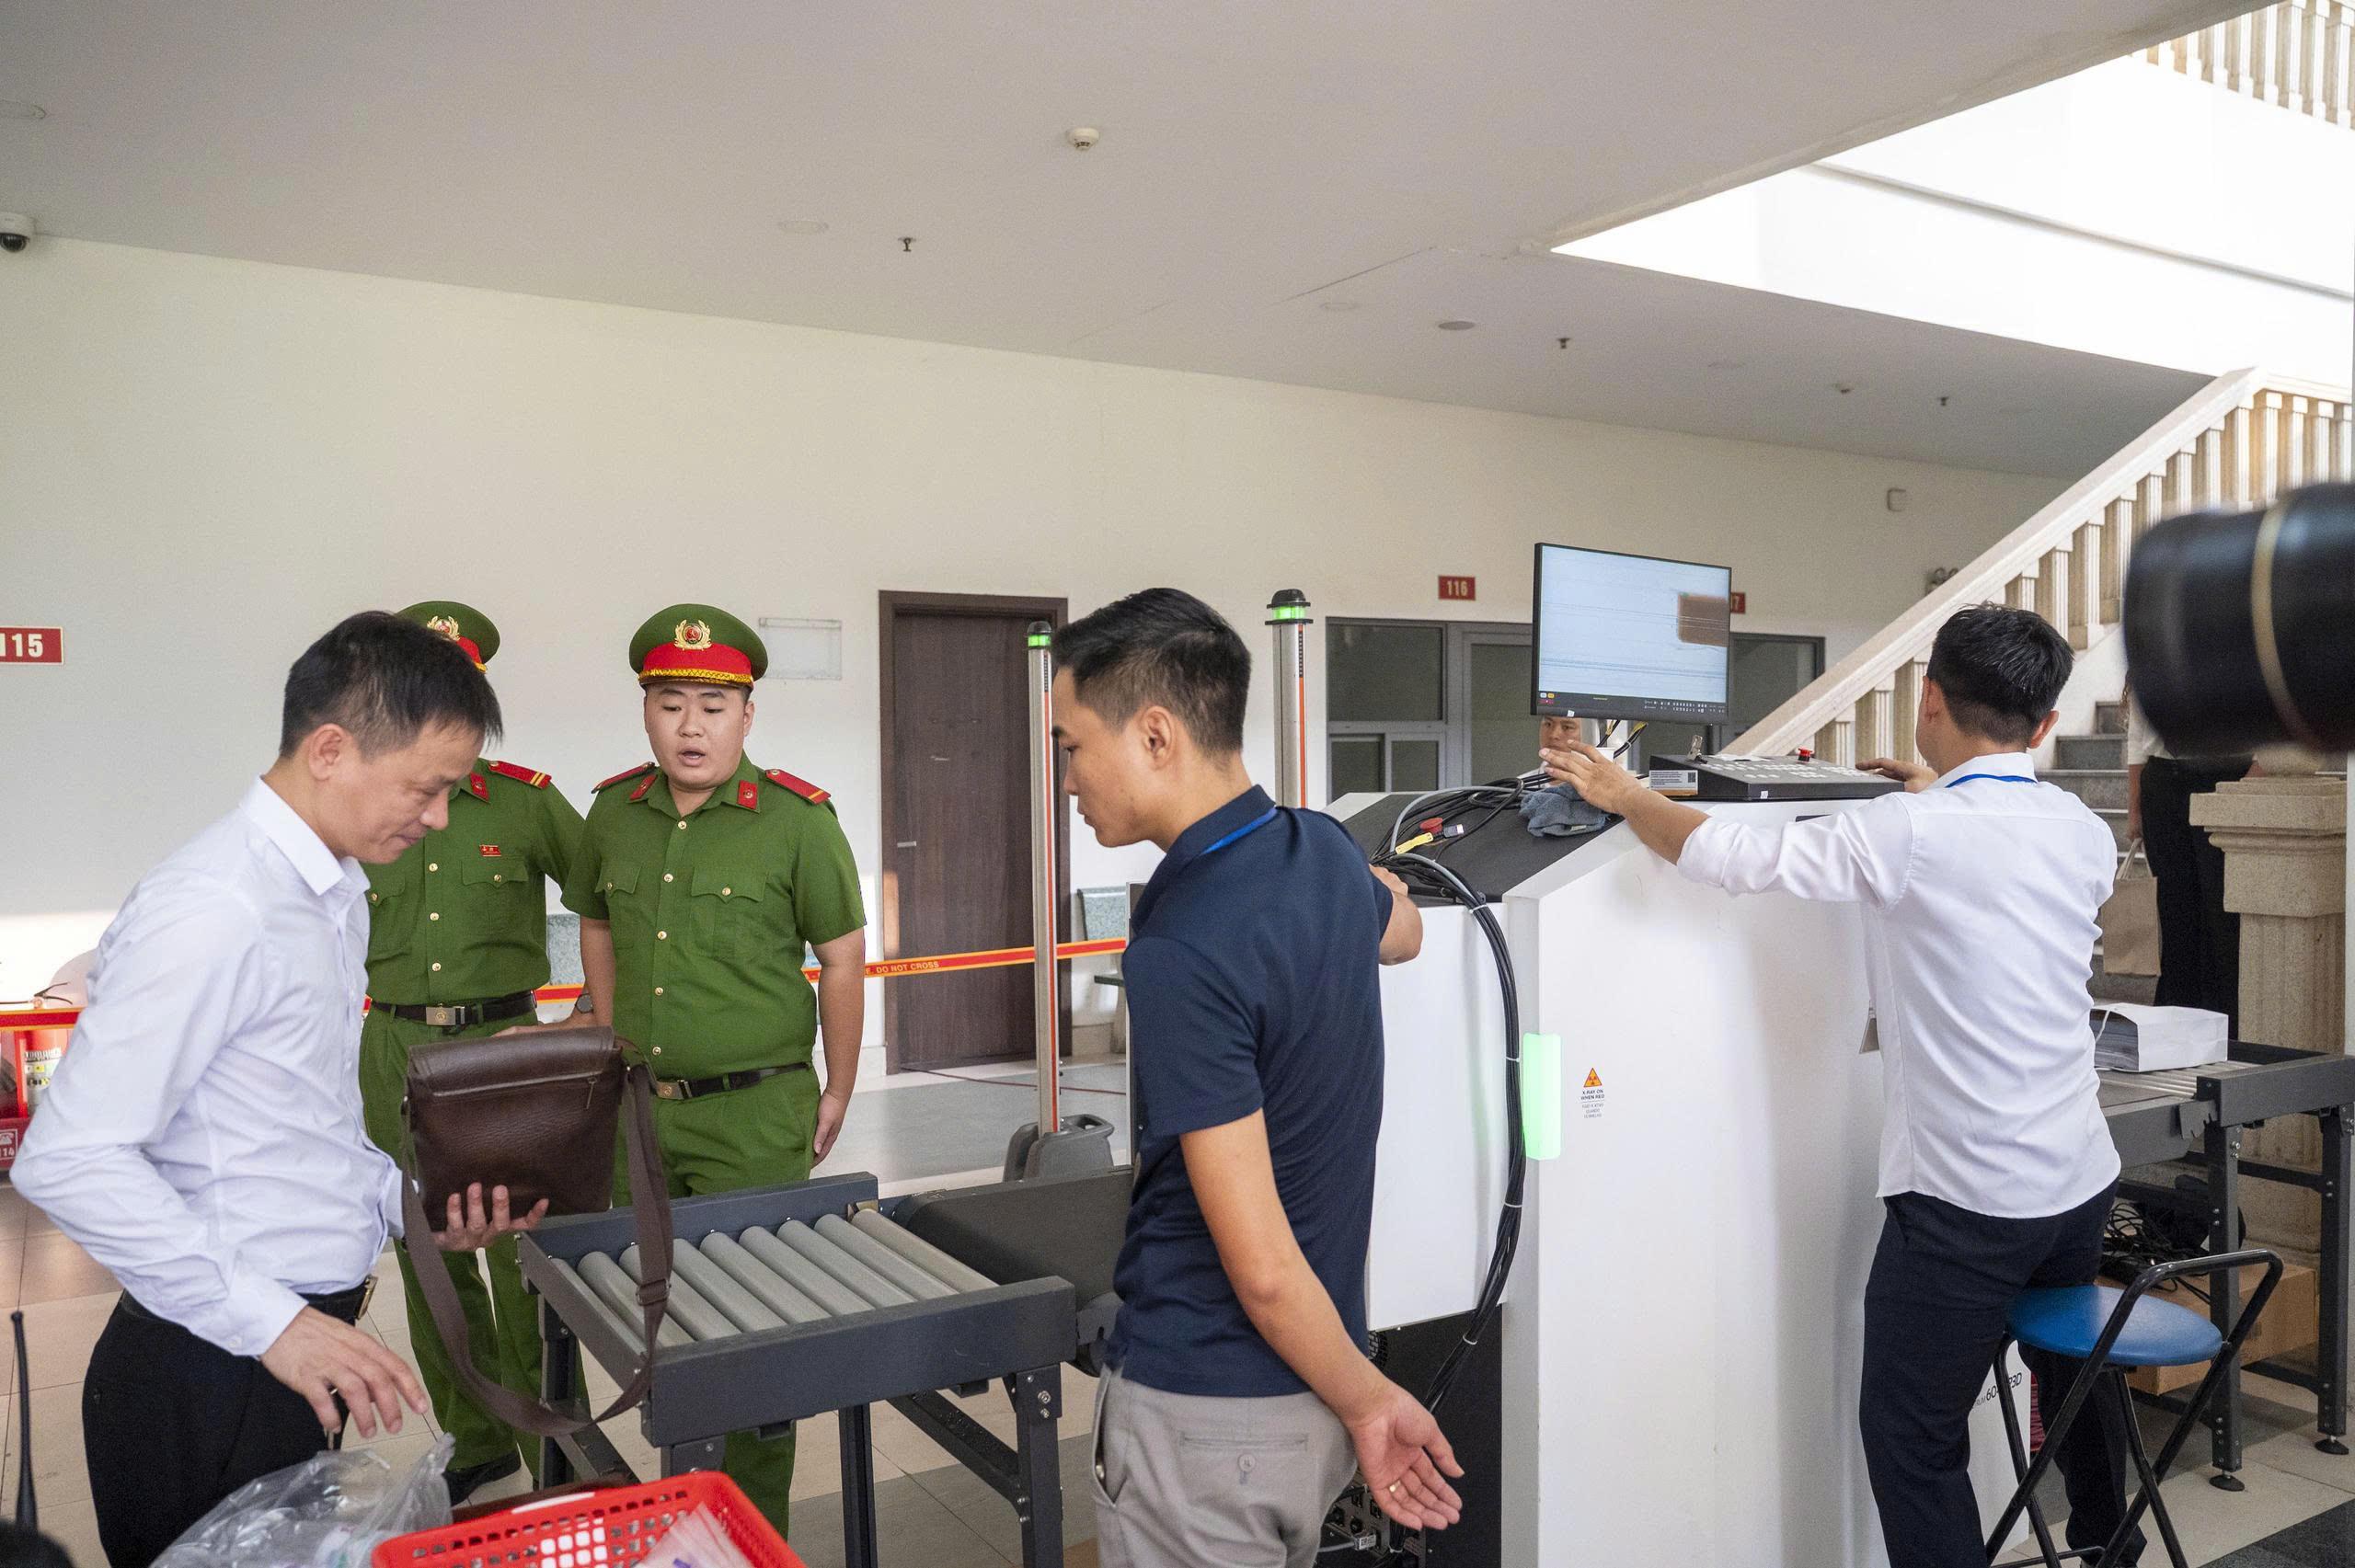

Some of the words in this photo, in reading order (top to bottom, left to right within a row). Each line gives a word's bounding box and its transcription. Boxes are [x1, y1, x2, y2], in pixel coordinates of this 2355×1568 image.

[1447, 580, 1468, 597] 116
[876, 966, 889, 974] DO
[890, 964, 908, 972] NOT
[910, 961, 939, 970] CROSS
[0, 1147, 15, 1157] 14
